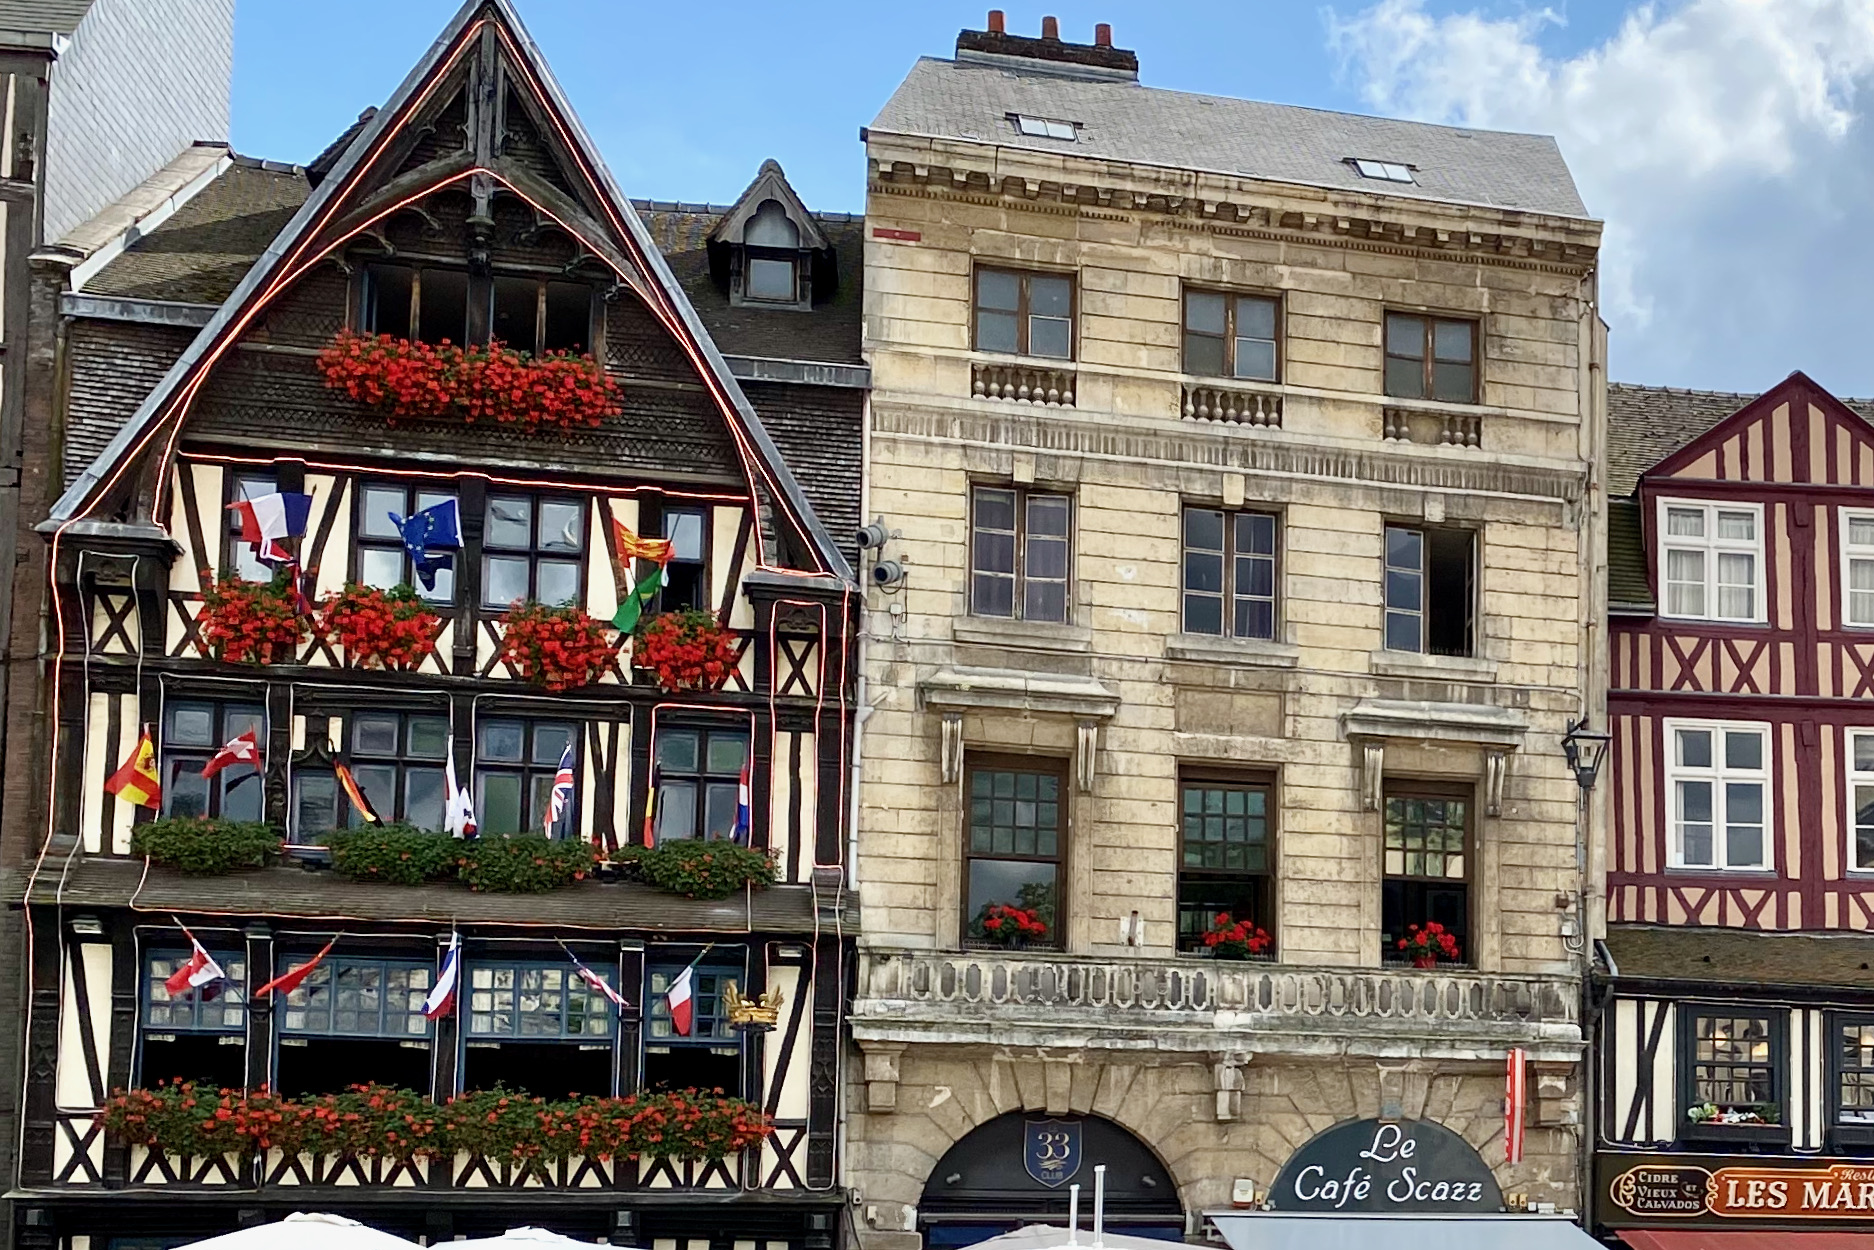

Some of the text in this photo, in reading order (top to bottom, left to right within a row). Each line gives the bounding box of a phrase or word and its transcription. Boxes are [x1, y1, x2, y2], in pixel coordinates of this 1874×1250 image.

[1035, 1131, 1070, 1159] 33
[1359, 1124, 1416, 1162] Le
[1040, 1170, 1064, 1180] CLUB
[1638, 1171, 1679, 1184] CIDRE
[1294, 1164, 1483, 1208] Café Scazz
[1637, 1185, 1679, 1199] VIEUX
[1685, 1184, 1698, 1192] ET
[1726, 1179, 1789, 1209] LES
[1636, 1197, 1700, 1210] CALVADOS
